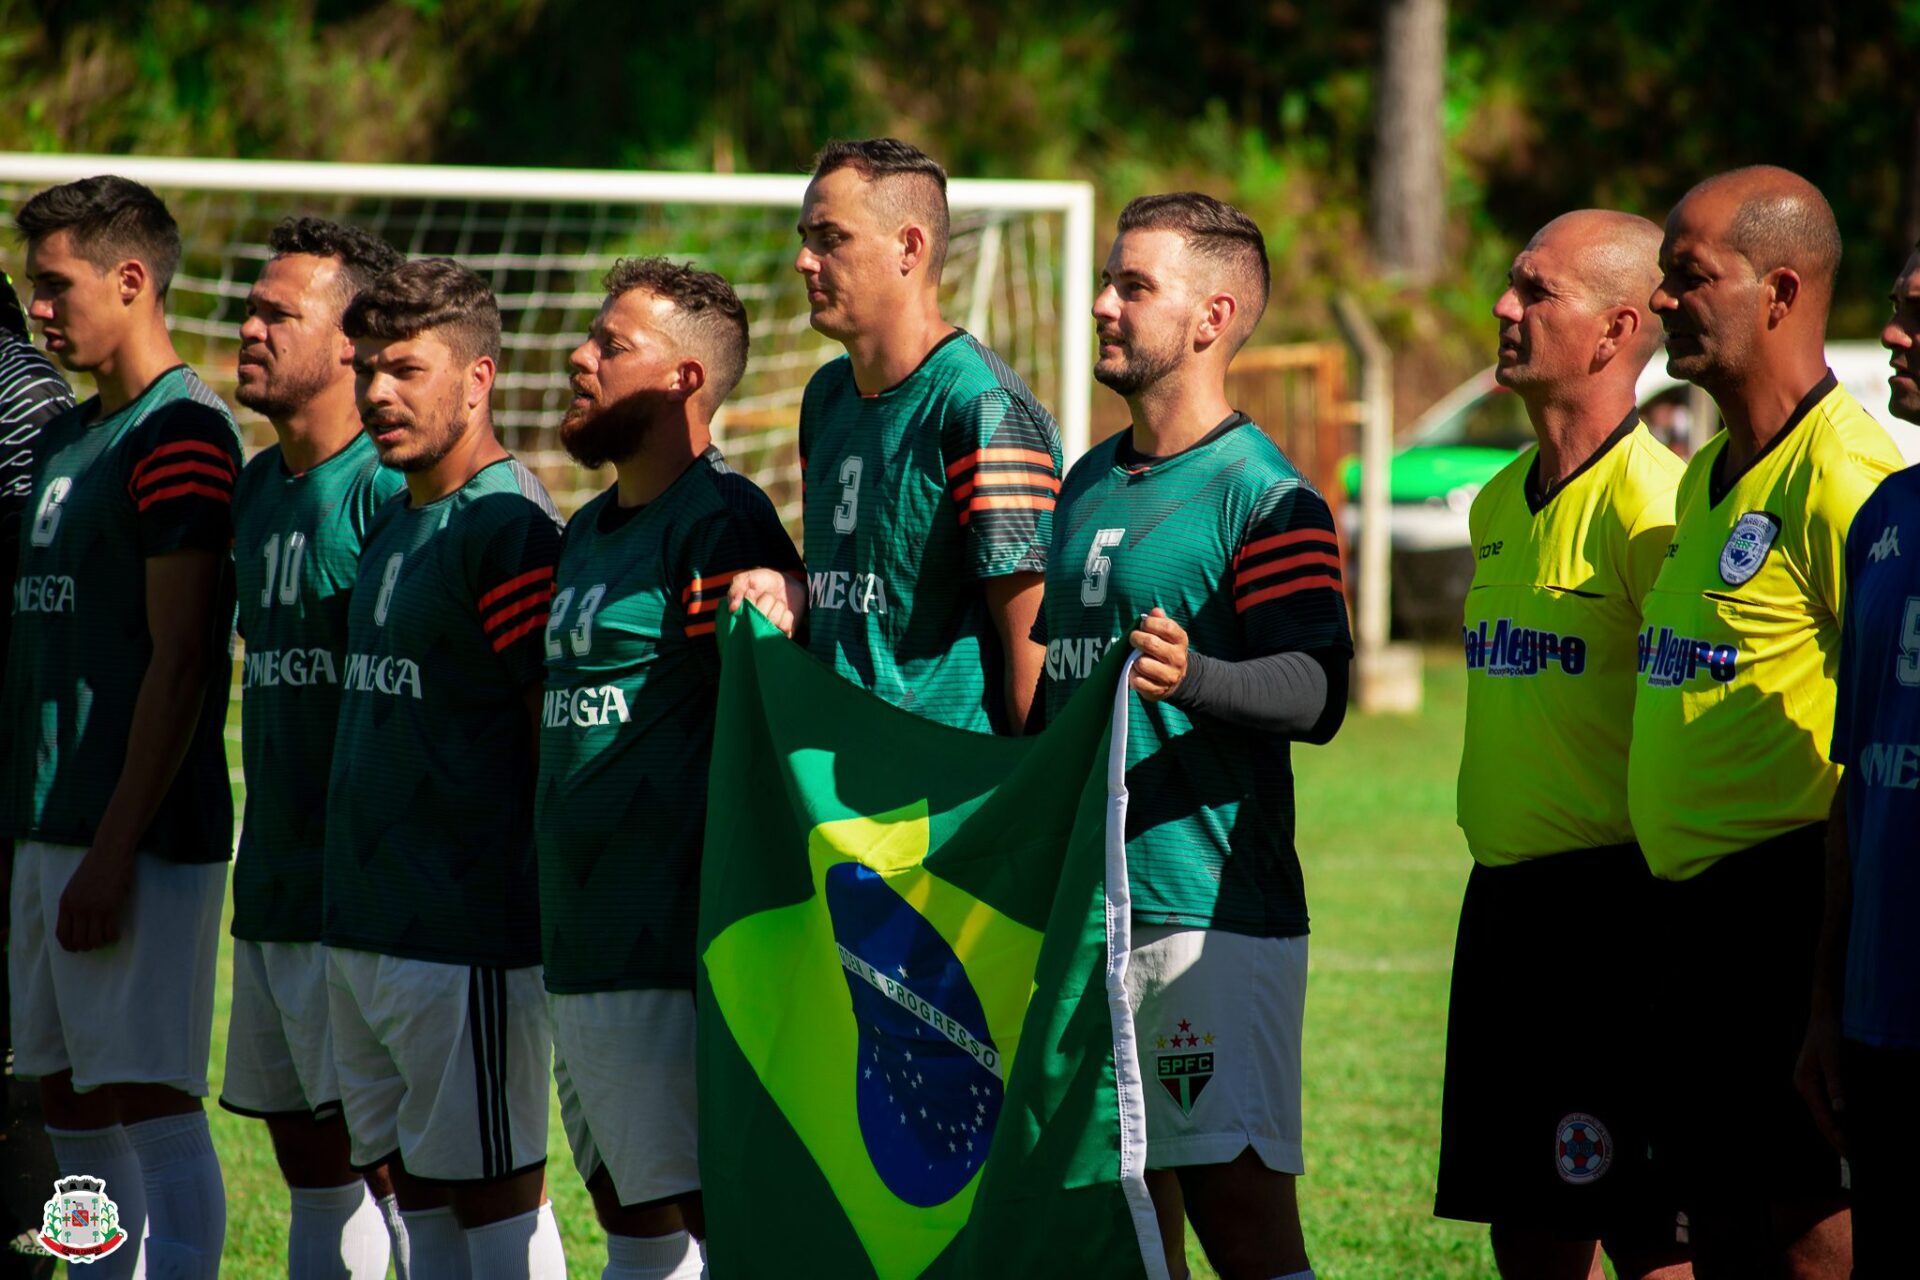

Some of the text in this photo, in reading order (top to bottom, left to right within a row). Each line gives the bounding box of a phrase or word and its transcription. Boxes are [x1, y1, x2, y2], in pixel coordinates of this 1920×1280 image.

[30, 476, 72, 547] 6
[833, 455, 863, 534] 3
[11, 574, 75, 616] MEGA
[261, 531, 306, 608] 10
[374, 552, 404, 627] 8
[807, 571, 888, 614] MEGA
[1081, 528, 1125, 607] 5
[544, 583, 607, 661] 23
[243, 647, 338, 690] MEGA
[344, 653, 423, 699] MEGA
[885, 979, 996, 1069] PROGRESSO
[1160, 1055, 1211, 1074] SPFC
